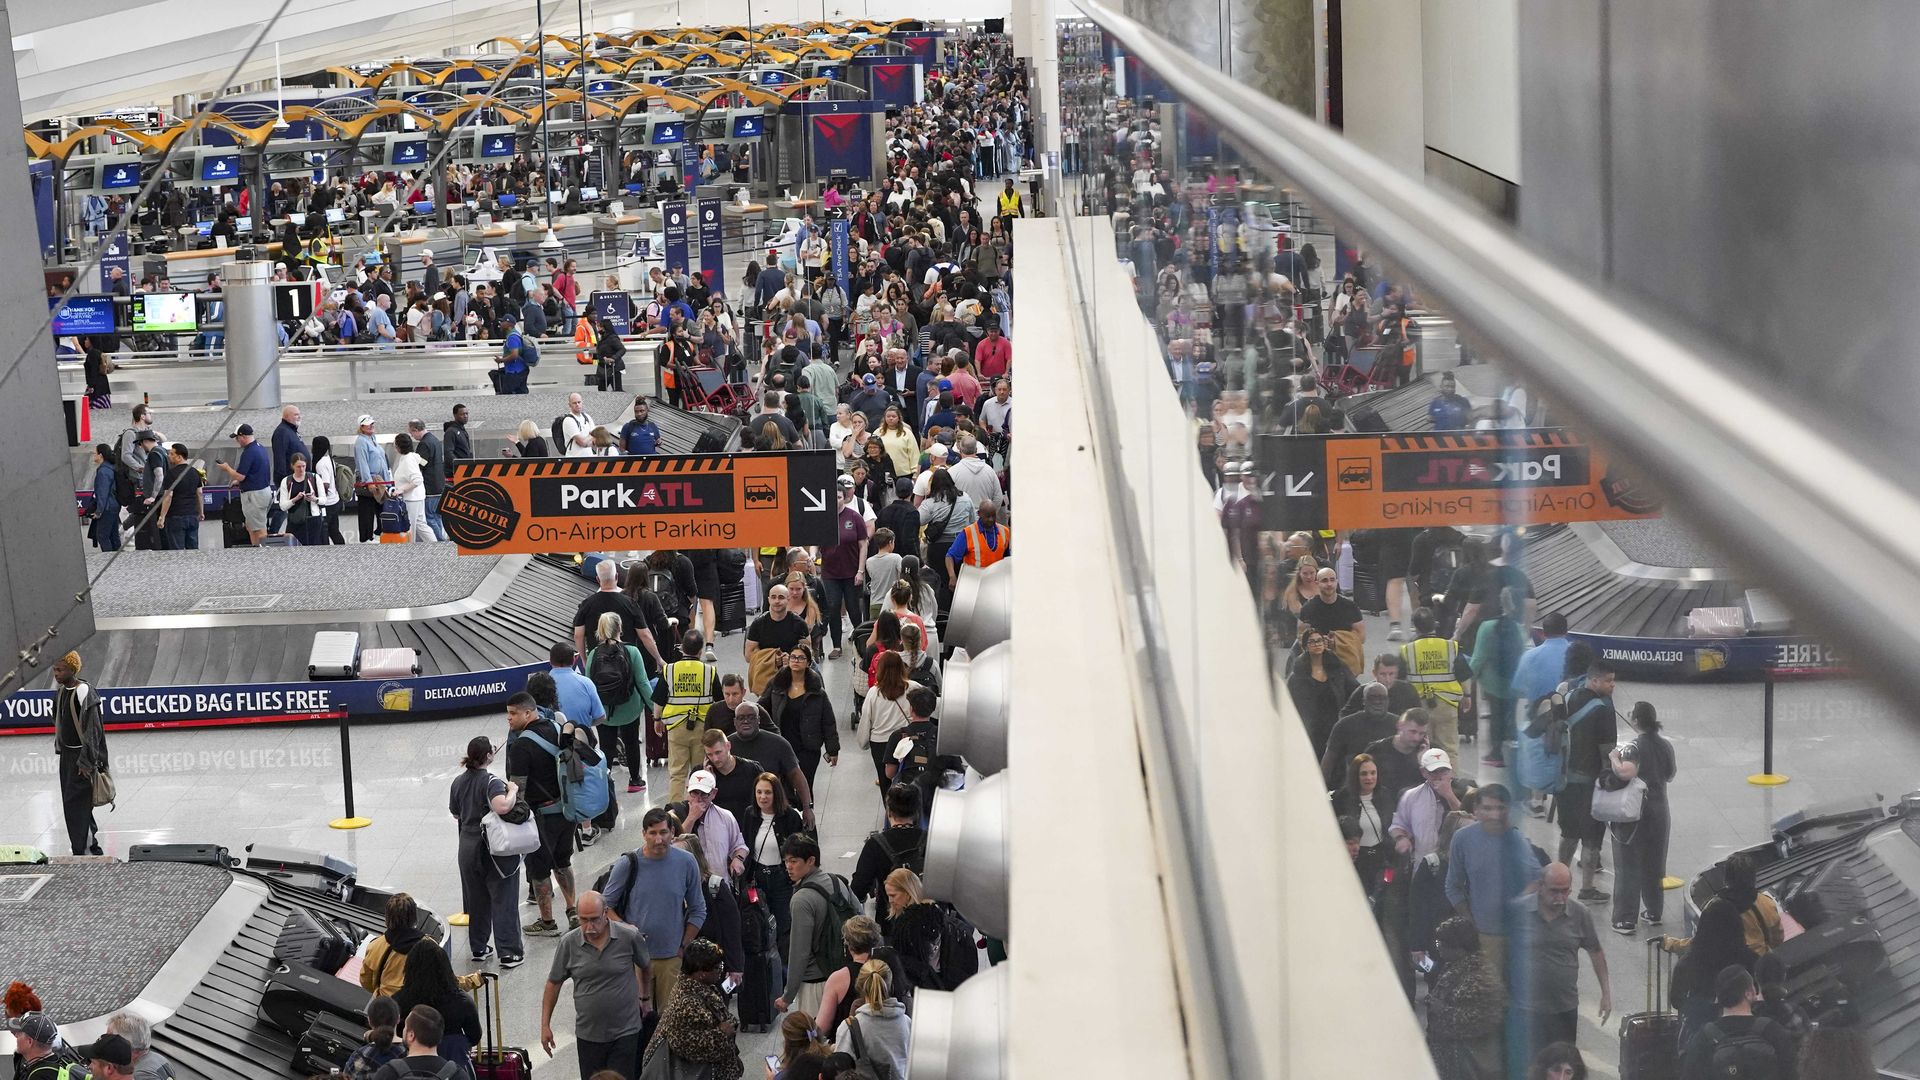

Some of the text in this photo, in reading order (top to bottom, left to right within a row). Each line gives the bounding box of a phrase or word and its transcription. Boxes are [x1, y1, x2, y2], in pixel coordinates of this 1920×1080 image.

[832, 104, 838, 112] 3
[288, 288, 300, 317] 1
[561, 481, 703, 510] ParkATL
[446, 497, 509, 529] DETOUR
[526, 519, 736, 544] On-Airport Parking
[674, 683, 701, 693] OPERATIONS
[678, 673, 697, 682] AIRPORT
[424, 682, 507, 700] DELTA.COM/AMEX
[4, 698, 54, 718] YOUR
[110, 692, 194, 715] CHECKED
[195, 692, 233, 713] BAG
[236, 690, 283, 712] FLIES
